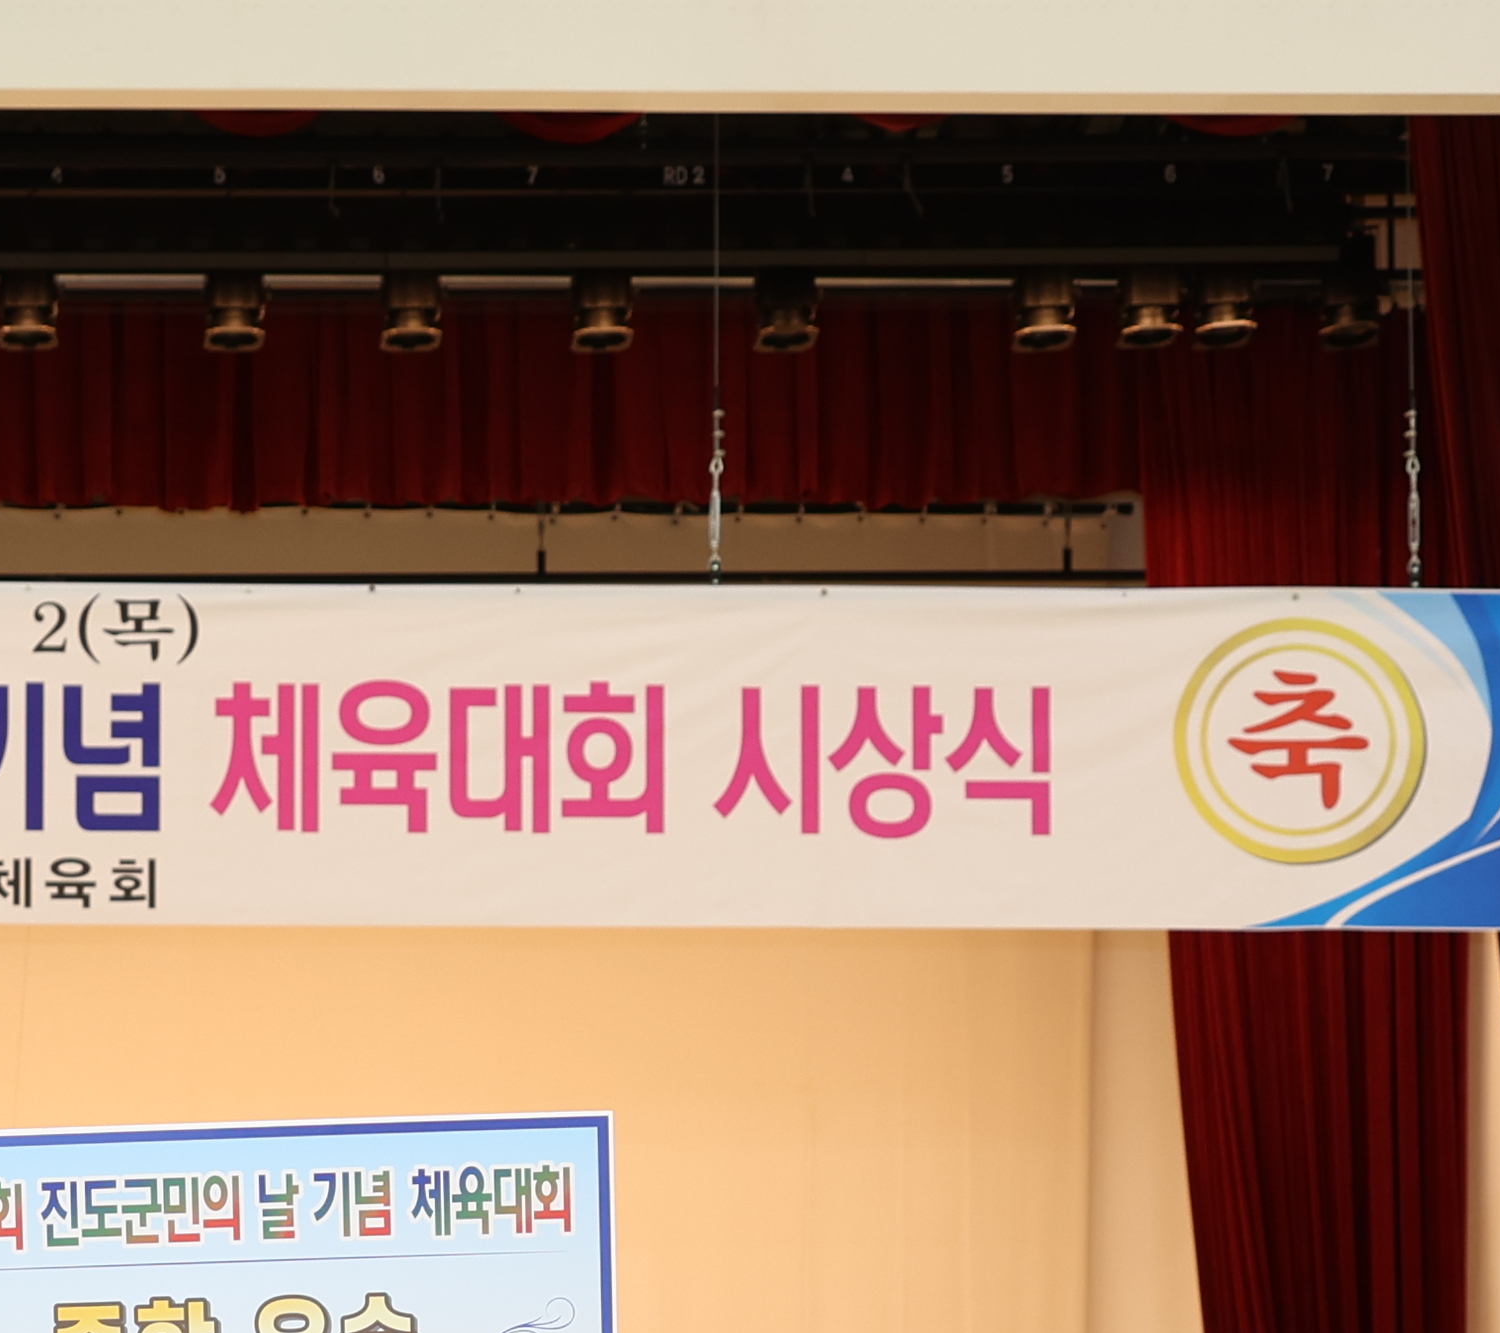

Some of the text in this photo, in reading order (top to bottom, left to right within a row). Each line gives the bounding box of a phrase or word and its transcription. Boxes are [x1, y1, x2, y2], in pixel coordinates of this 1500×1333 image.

[32, 593, 200, 665] 2(목)
[211, 678, 668, 837] 체육대회
[713, 683, 1055, 840] 시상식
[1225, 667, 1370, 812] 축
[39, 1172, 242, 1249] 진도군민의
[257, 1172, 301, 1241] 날
[312, 1168, 392, 1239] 기념
[410, 1163, 574, 1237] 체육대회
